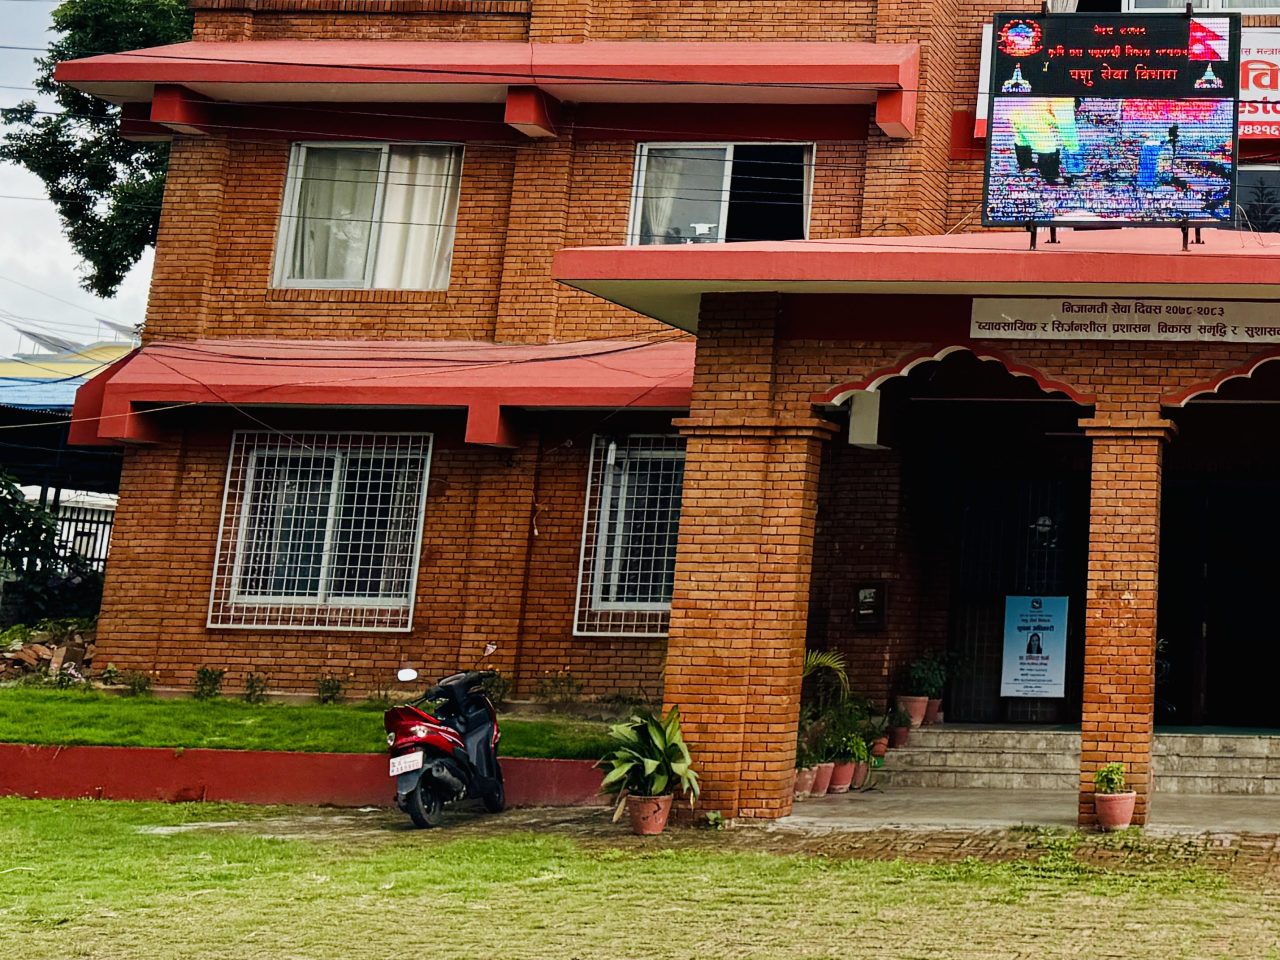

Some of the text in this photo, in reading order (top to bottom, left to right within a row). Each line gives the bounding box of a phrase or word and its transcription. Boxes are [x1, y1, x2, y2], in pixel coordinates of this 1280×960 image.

[1062, 301, 1108, 315] निजामती
[1111, 301, 1131, 315] सेवा
[1134, 302, 1162, 315] दिवस
[1041, 322, 1049, 332] र
[1112, 322, 1151, 334] प्रशासन
[1158, 321, 1193, 335] विकास
[1231, 325, 1239, 336] र
